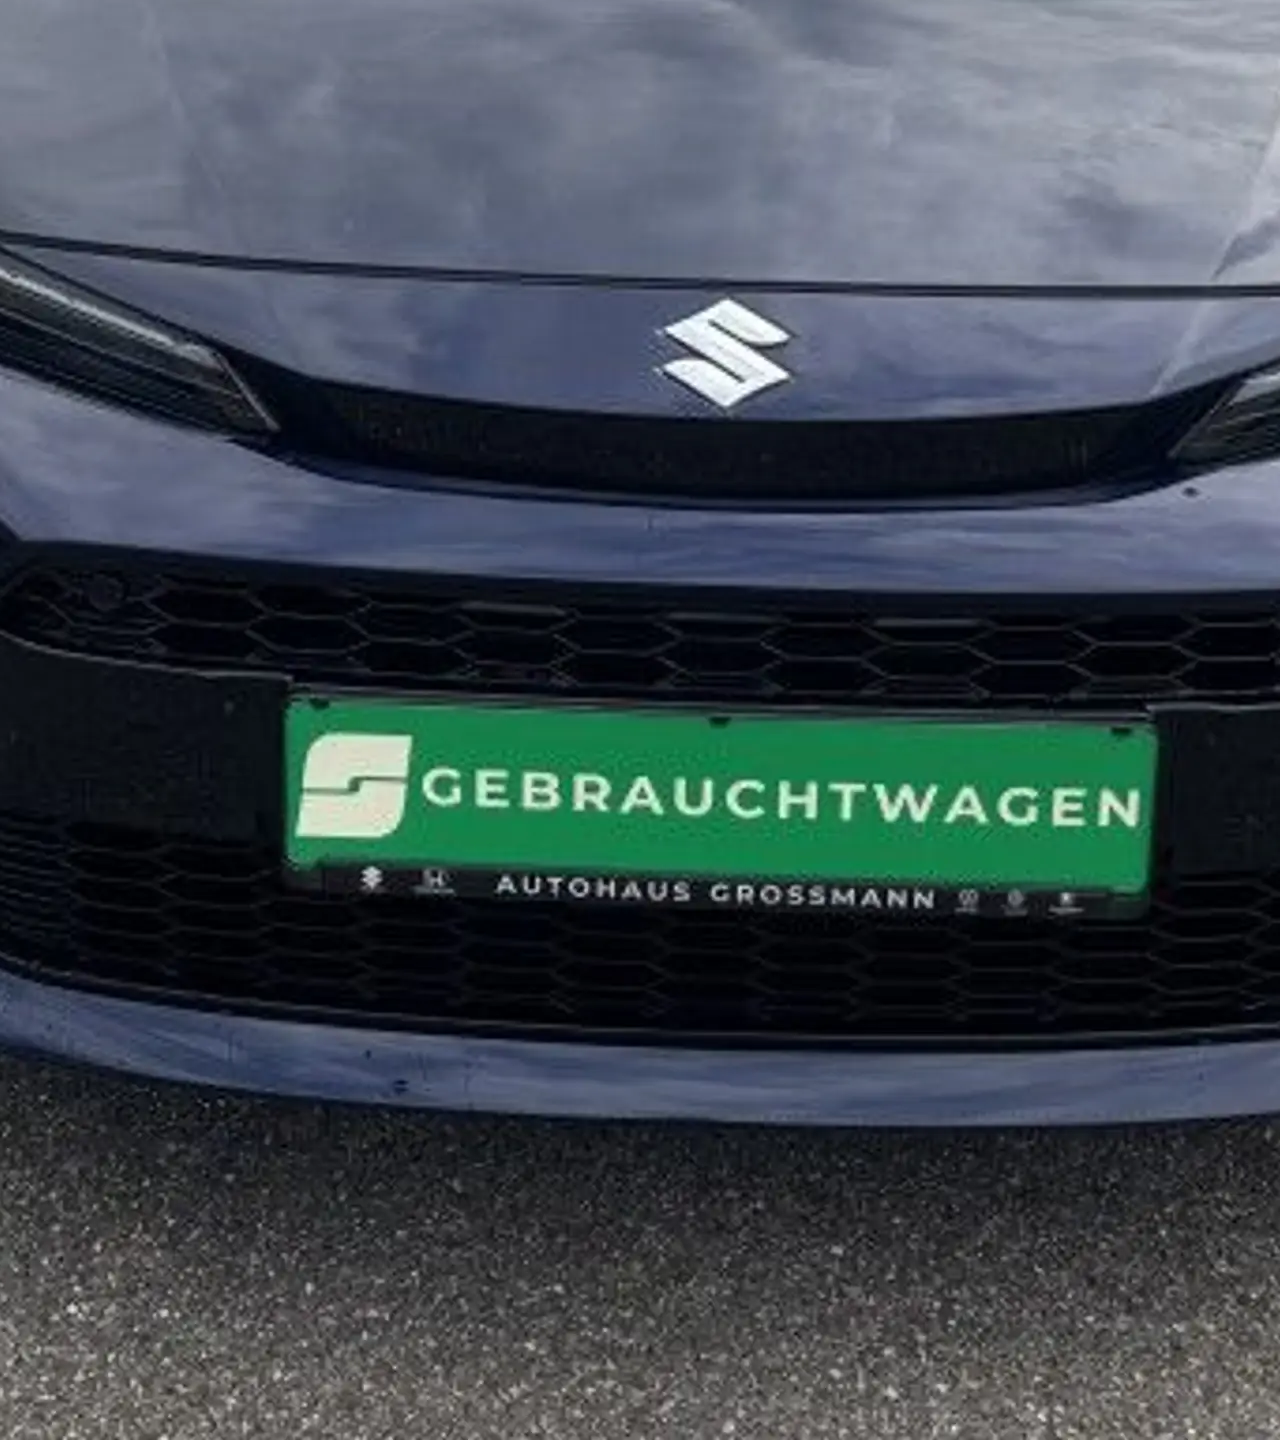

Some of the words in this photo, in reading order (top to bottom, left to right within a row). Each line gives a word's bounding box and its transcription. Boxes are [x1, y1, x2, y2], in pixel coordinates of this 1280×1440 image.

[421, 765, 1141, 828] GEBRAUCHTWAGEN
[494, 874, 692, 902] AUTOHAUS
[709, 881, 936, 909] GROSSMANN
